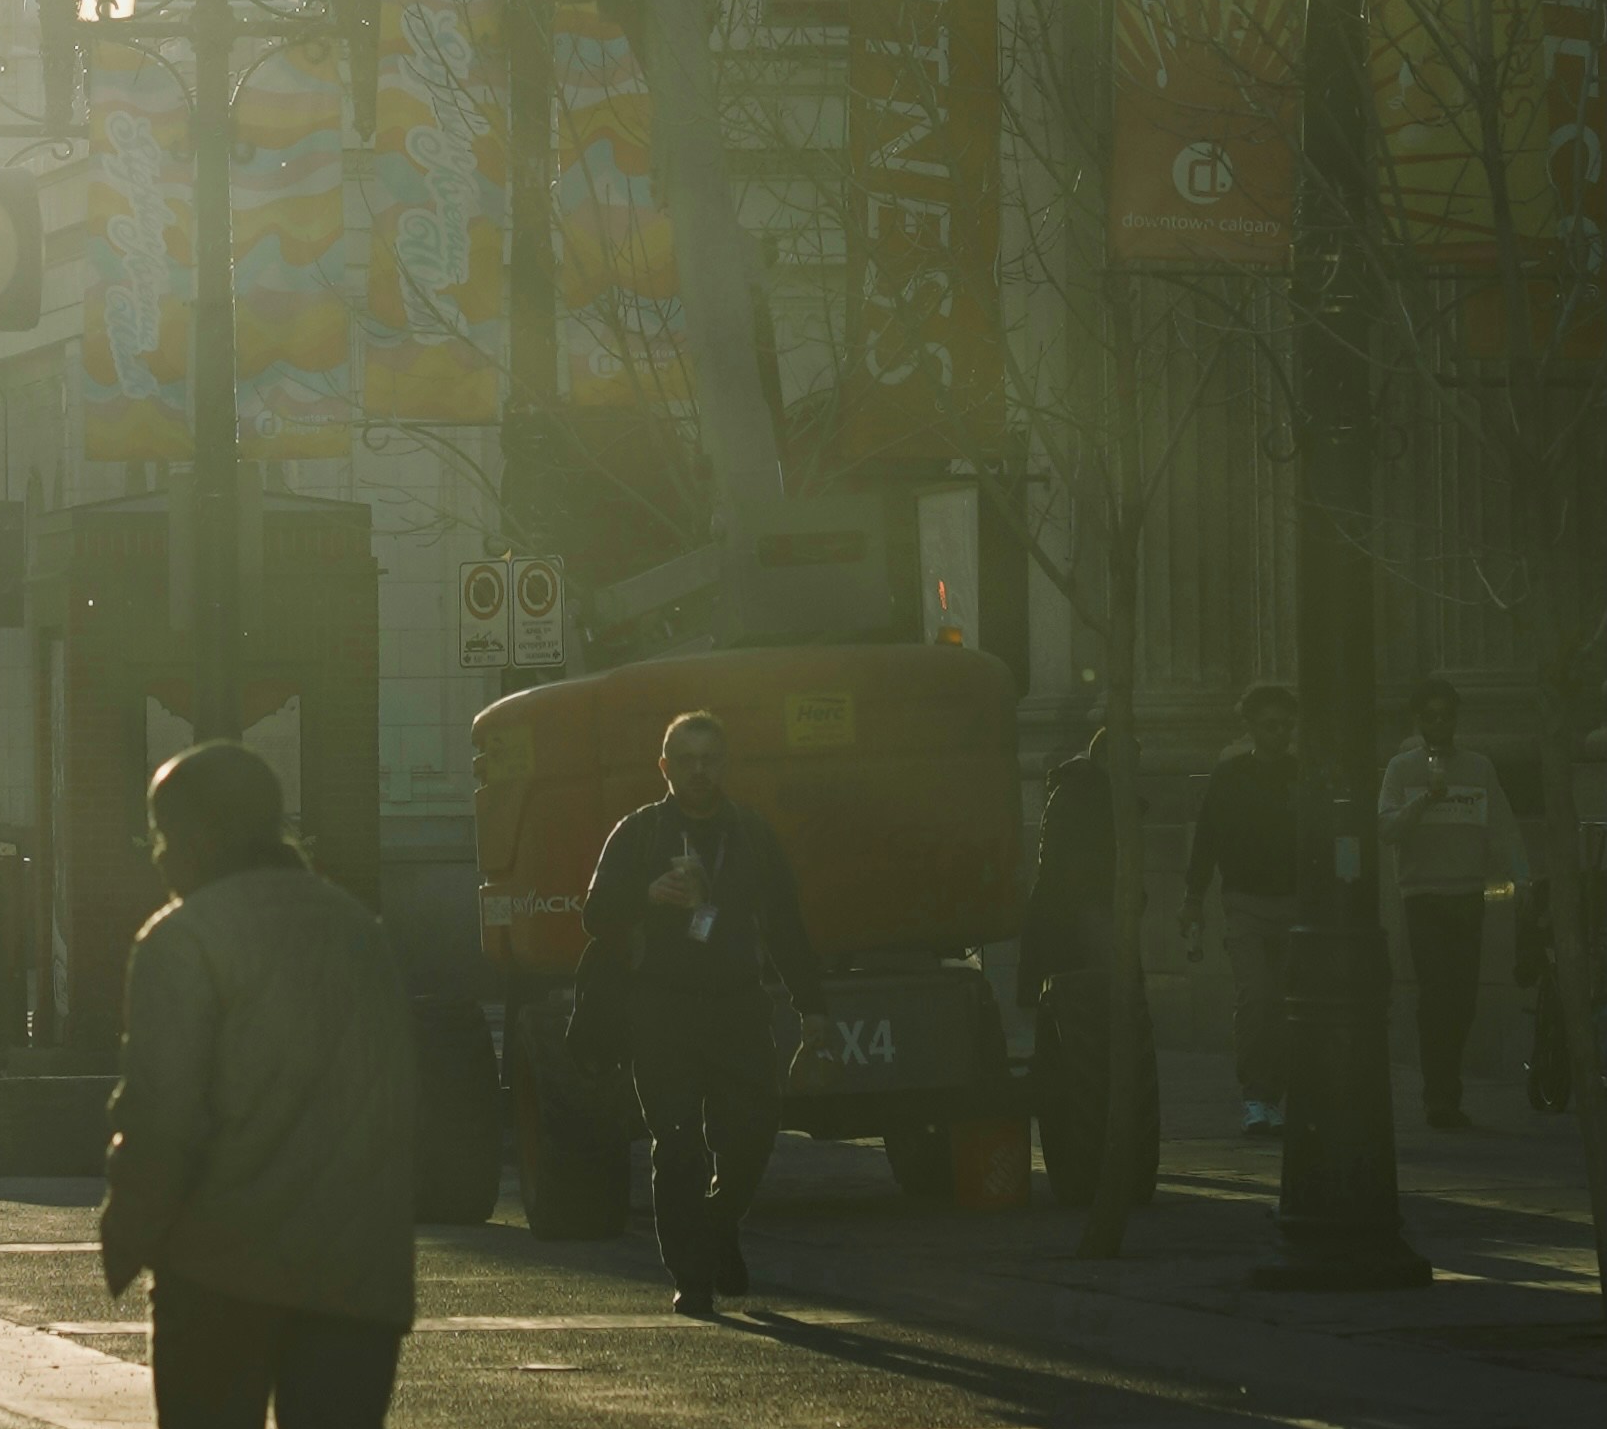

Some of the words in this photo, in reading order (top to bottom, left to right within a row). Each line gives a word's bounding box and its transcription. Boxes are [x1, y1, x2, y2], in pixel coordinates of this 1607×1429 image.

[1121, 212, 1215, 230] downtown
[1219, 216, 1281, 237] calgary
[815, 1018, 897, 1065] X4
